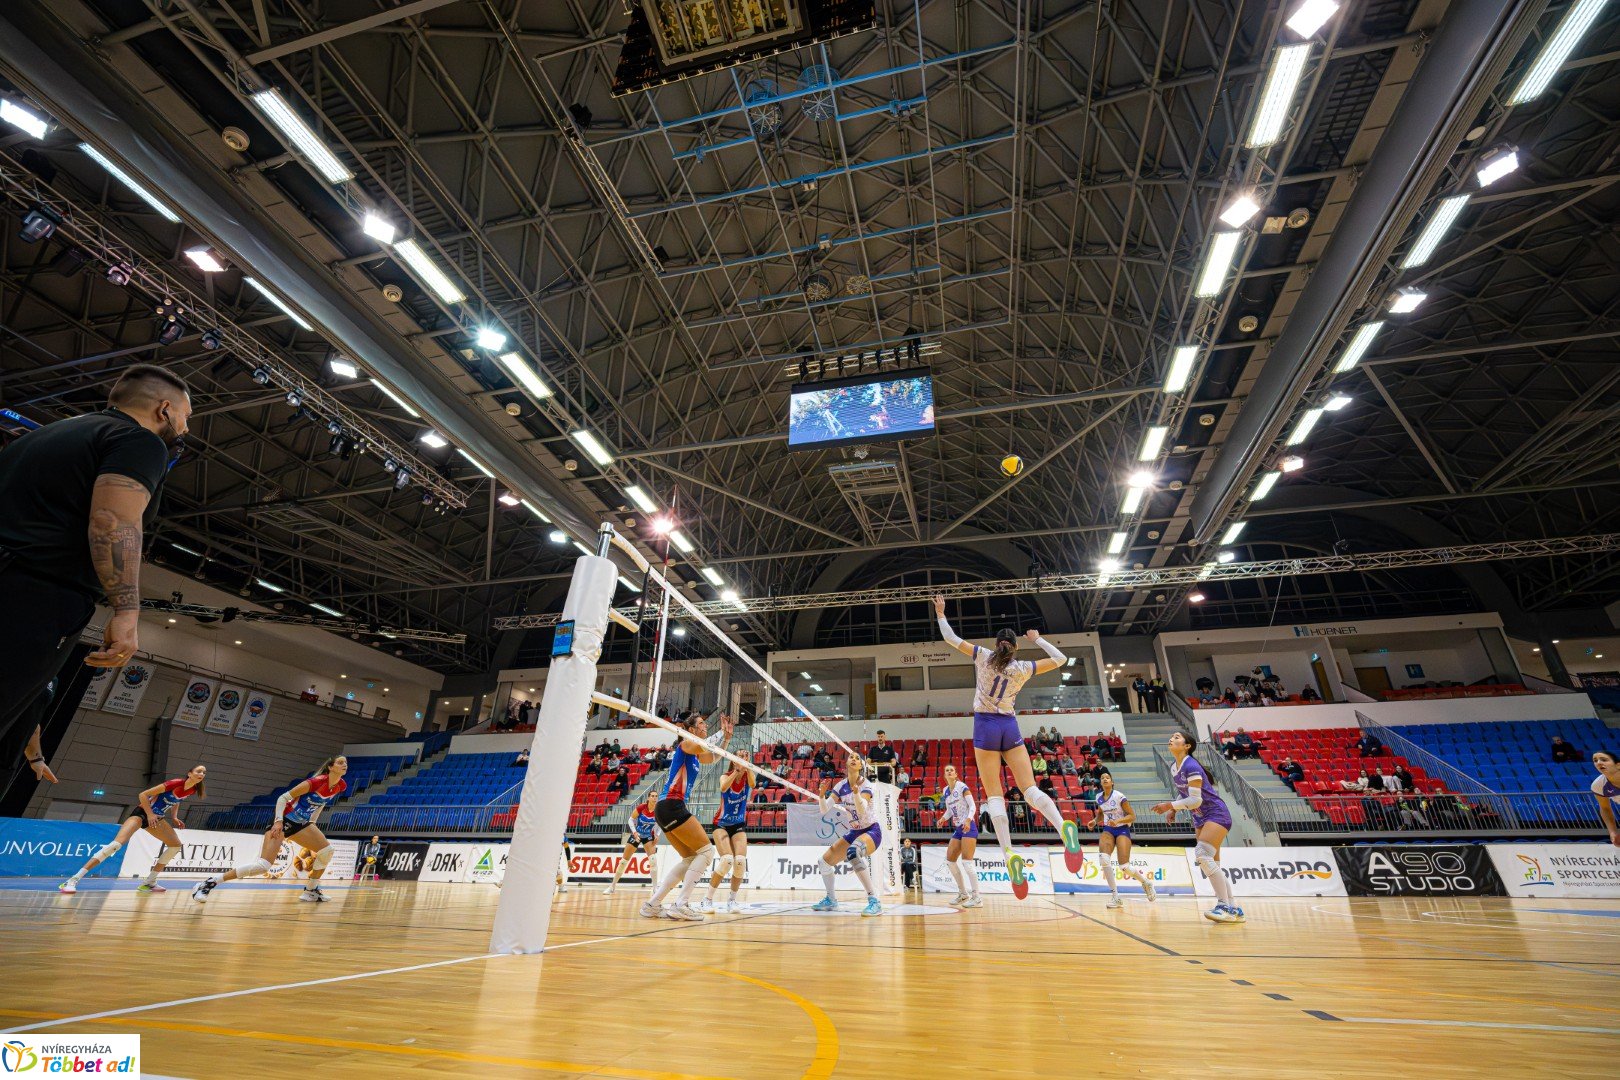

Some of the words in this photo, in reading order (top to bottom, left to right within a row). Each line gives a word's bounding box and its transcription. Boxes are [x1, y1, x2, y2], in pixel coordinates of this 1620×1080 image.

[1310, 626, 1358, 636] HÜBNER
[989, 675, 1009, 698] 11
[1369, 876, 1476, 891] STUDIO
